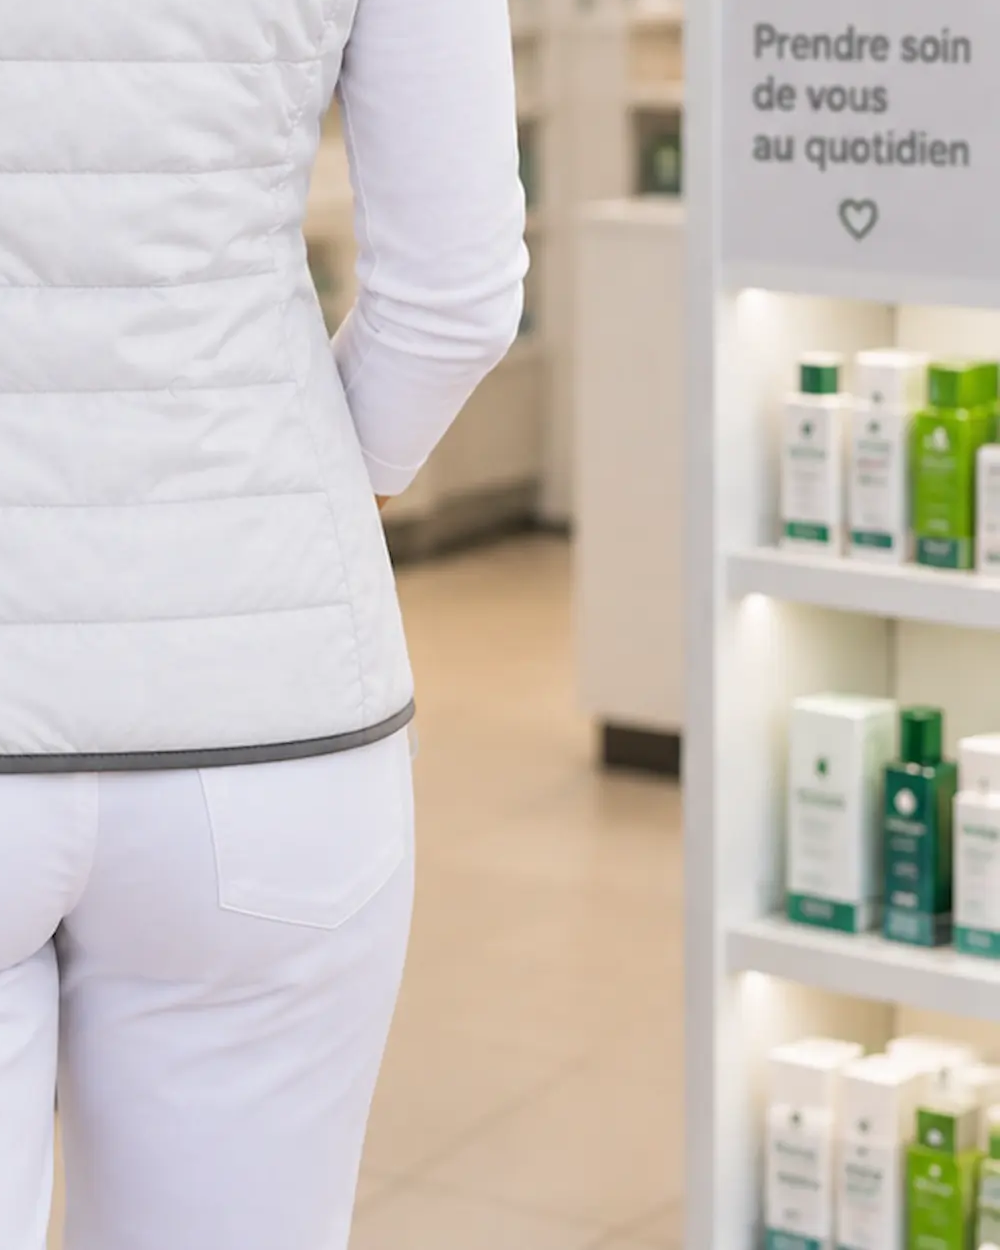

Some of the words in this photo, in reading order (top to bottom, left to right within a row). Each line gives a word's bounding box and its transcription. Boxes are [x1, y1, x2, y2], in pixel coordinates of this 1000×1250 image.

[753, 22, 890, 62] Prendre
[899, 26, 972, 64] soin
[752, 74, 797, 112] de
[806, 83, 890, 114] vous
[752, 134, 796, 163] au
[804, 129, 971, 173] quotidien
